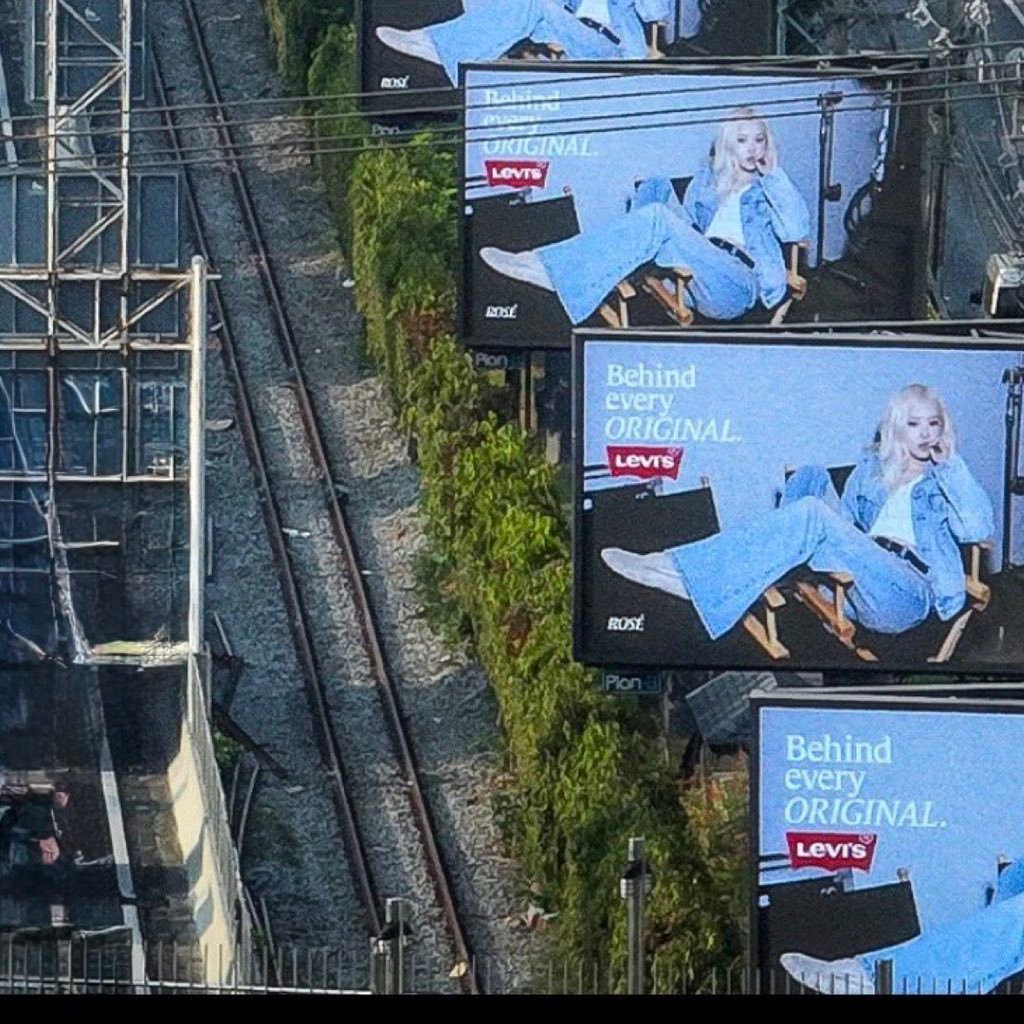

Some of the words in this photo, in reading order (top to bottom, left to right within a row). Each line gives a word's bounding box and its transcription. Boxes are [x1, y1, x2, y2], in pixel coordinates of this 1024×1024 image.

[606, 362, 697, 388] Behind
[604, 391, 675, 417] every
[604, 415, 744, 444] ORIGINAL.
[786, 733, 893, 764] Behind
[784, 767, 866, 797] every
[784, 796, 948, 829] ORIGINAL.
[796, 841, 867, 859] Levi's
